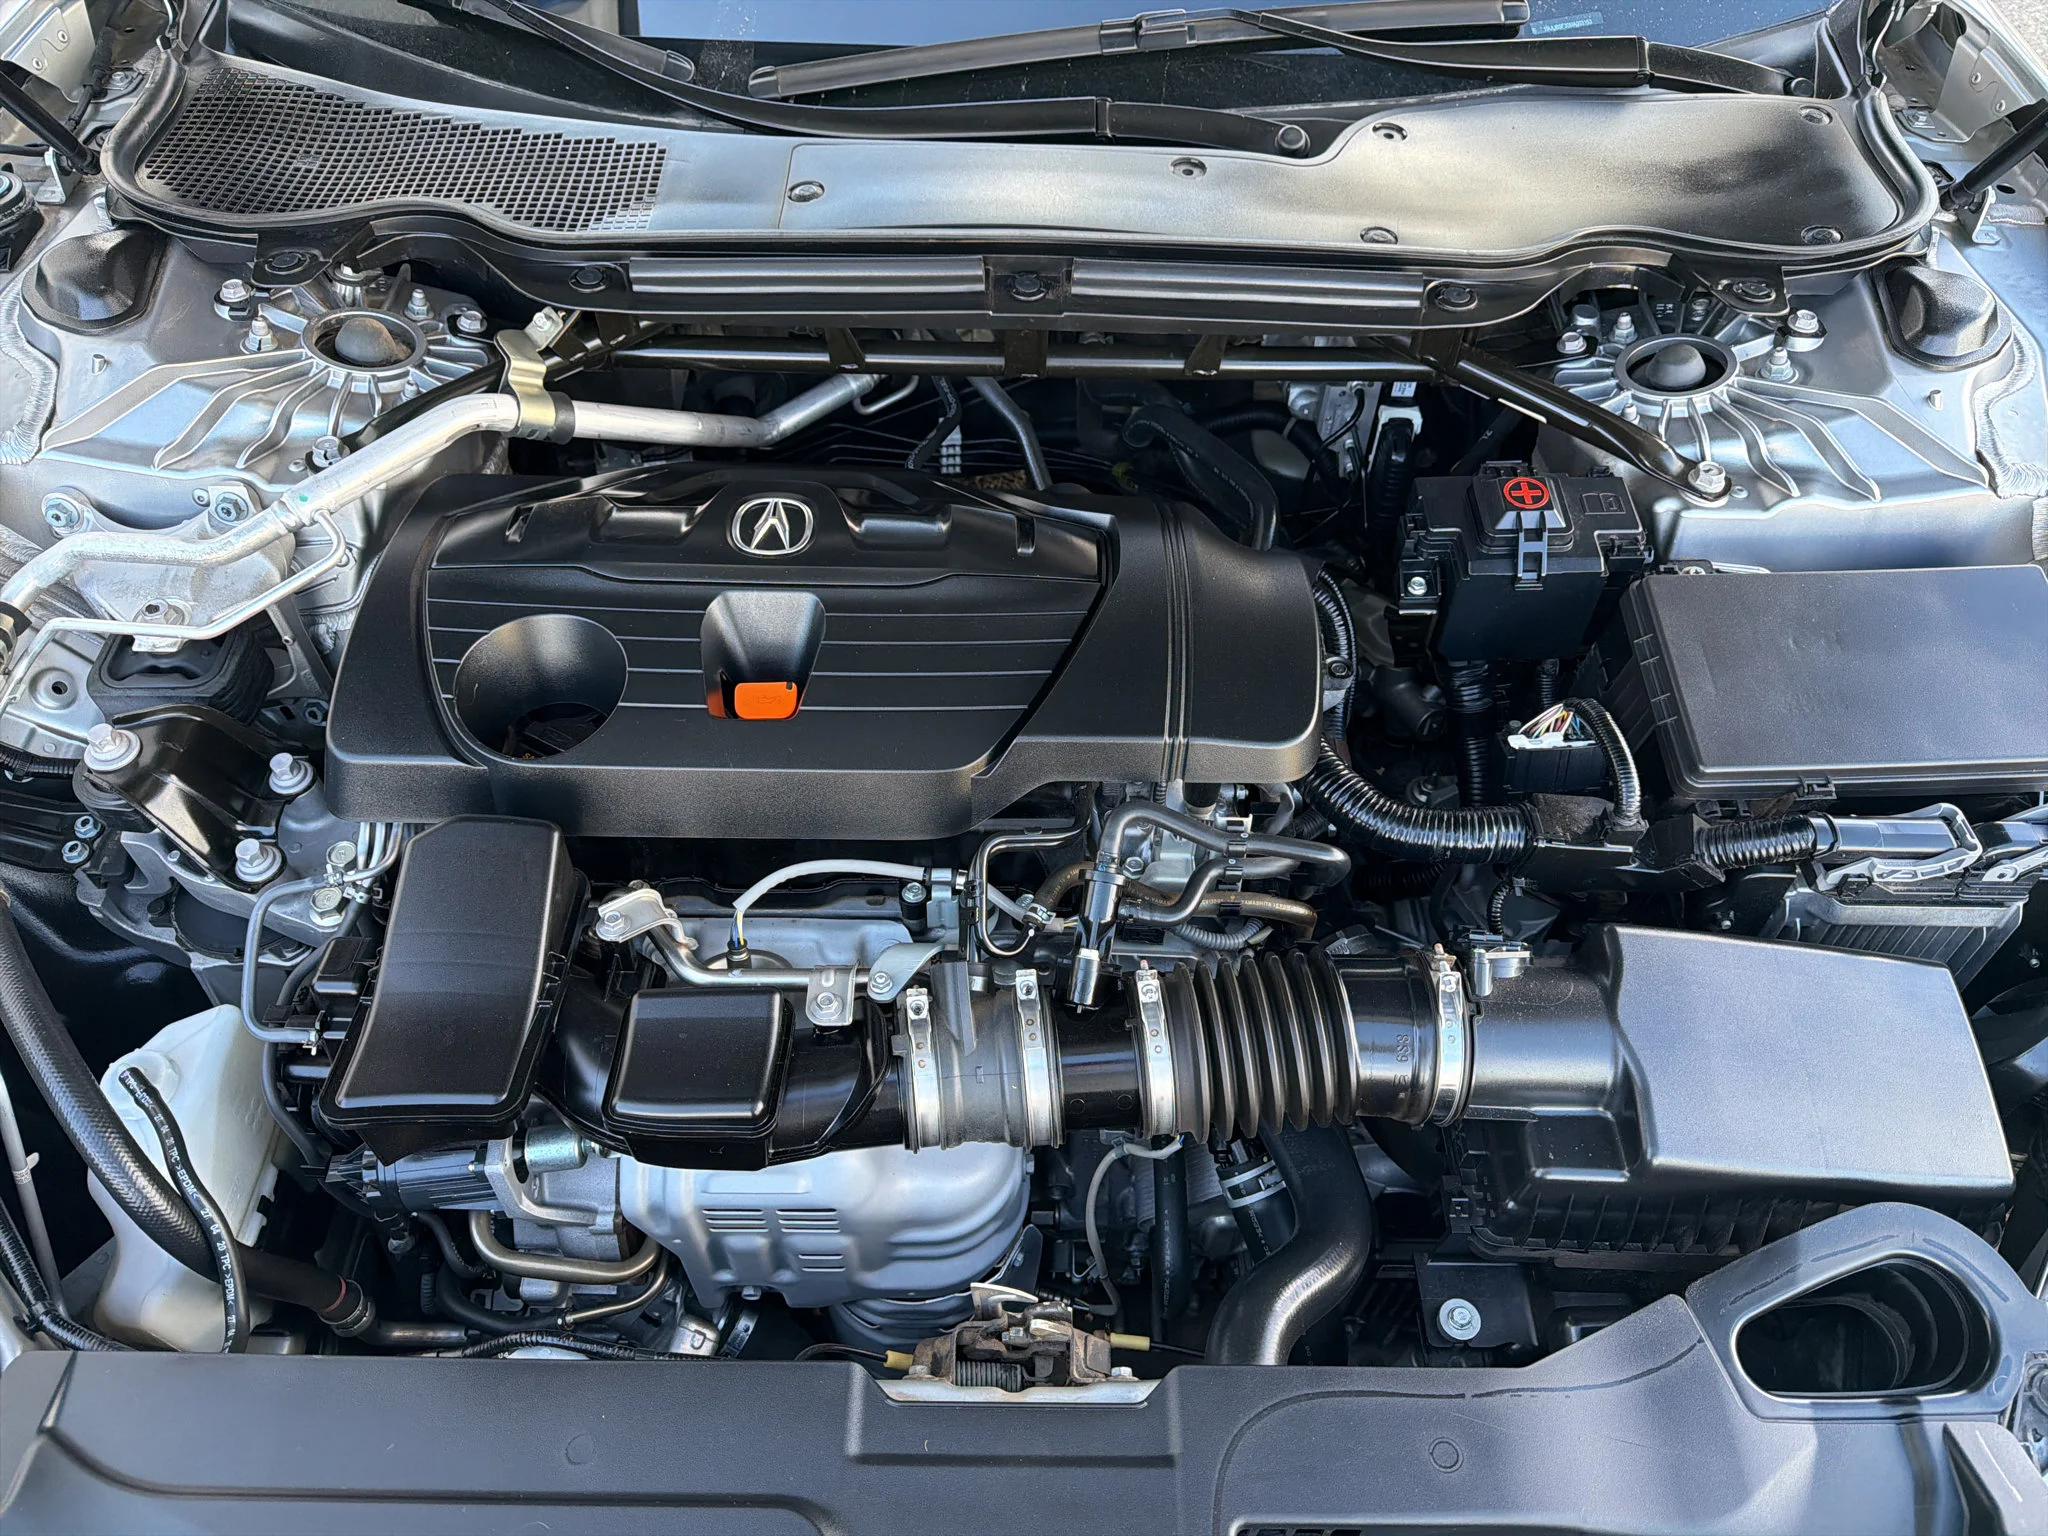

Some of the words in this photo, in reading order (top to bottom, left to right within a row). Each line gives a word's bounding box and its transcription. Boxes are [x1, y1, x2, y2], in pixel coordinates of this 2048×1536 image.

[169, 1146, 180, 1162] TPC
[210, 1224, 220, 1235] 04
[217, 1241, 226, 1251] 20
[221, 1253, 231, 1270] TPC
[224, 1273, 235, 1306] >EPDM<
